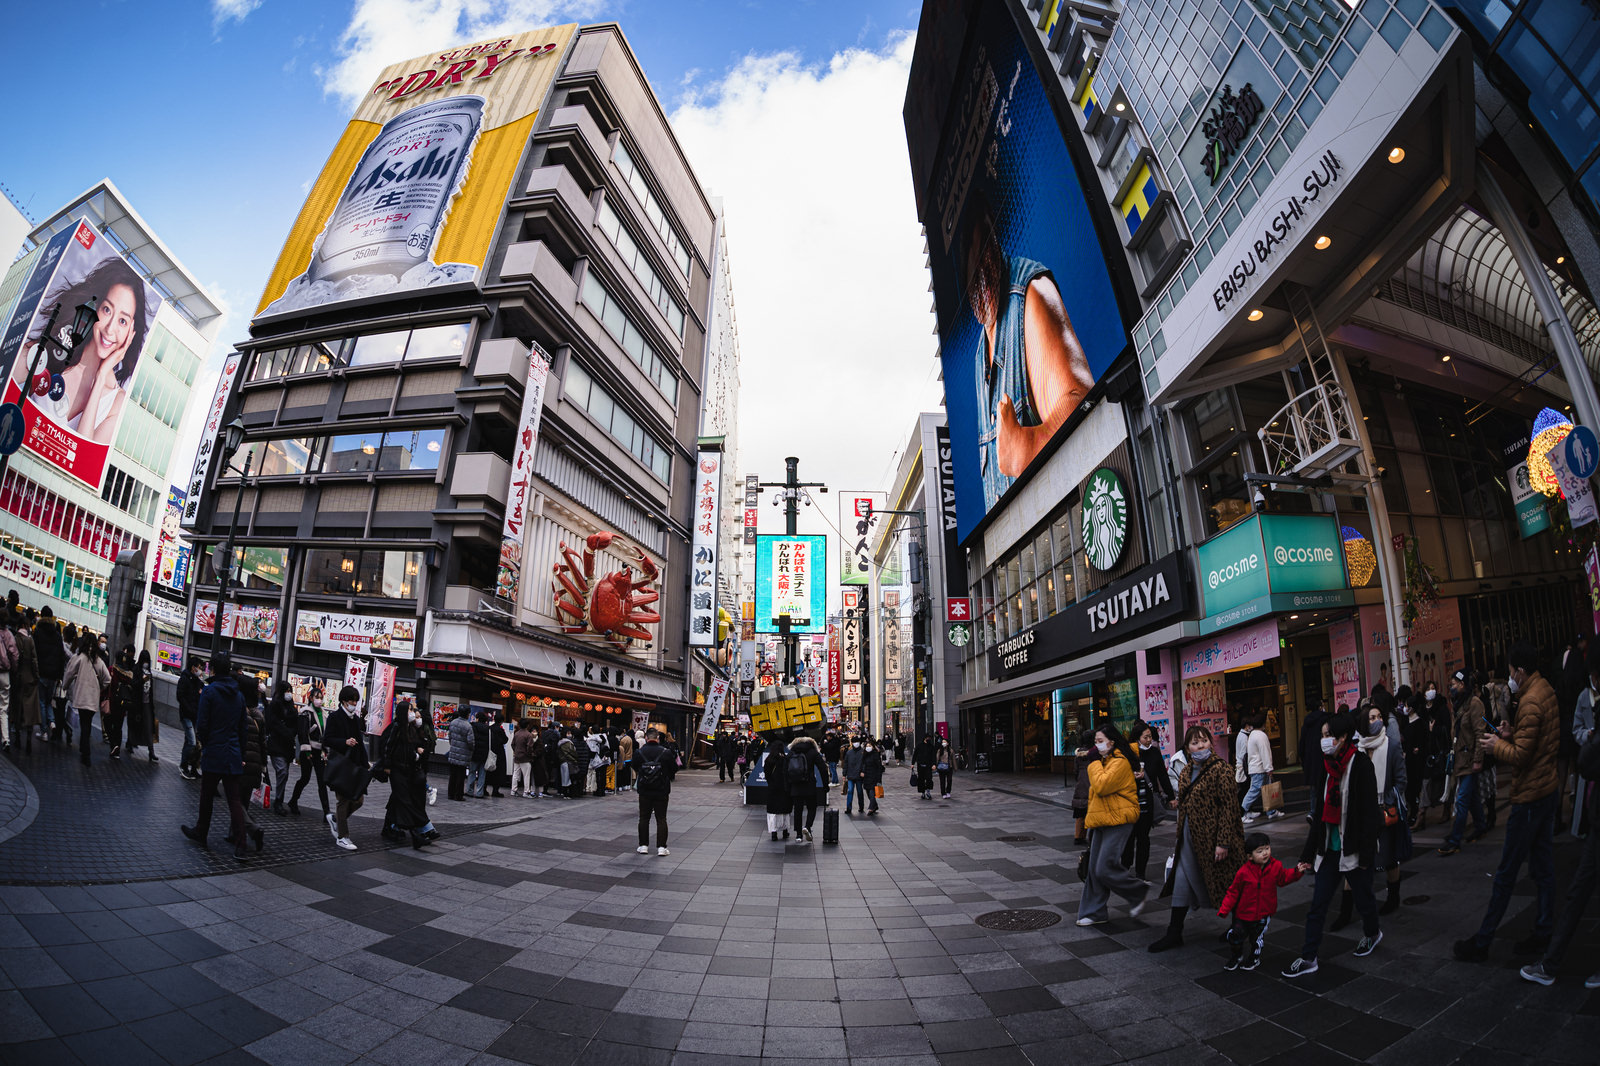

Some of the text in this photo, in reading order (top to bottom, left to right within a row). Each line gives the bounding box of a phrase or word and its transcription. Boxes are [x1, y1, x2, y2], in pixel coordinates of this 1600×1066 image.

[433, 38, 513, 66] SUPER
[429, 127, 453, 135] BRAND
[348, 146, 460, 199] Asahi
[372, 191, 406, 211] 生
[350, 212, 412, 233] スーパードライ
[352, 246, 380, 260] 350ml
[1211, 251, 1257, 312] EBISU
[208, 380, 230, 433] 本場の味
[184, 438, 213, 519] かに道楽
[938, 437, 958, 530] TSUTAYA
[698, 479, 716, 537] 本場の味
[1208, 553, 1259, 590] @cosme
[1273, 545, 1334, 566] @cosme
[692, 546, 714, 635] かに道楽
[1087, 572, 1171, 633] TSUTAYA
[1293, 594, 1342, 606] @cosme STORE
[950, 601, 966, 617] 本
[1215, 604, 1258, 626] @cosme STORE
[997, 629, 1035, 658] STARBUCKS
[1004, 649, 1028, 669] COFFEE
[830, 651, 839, 692] ツルハドラッグ
[751, 695, 823, 732] 2025
